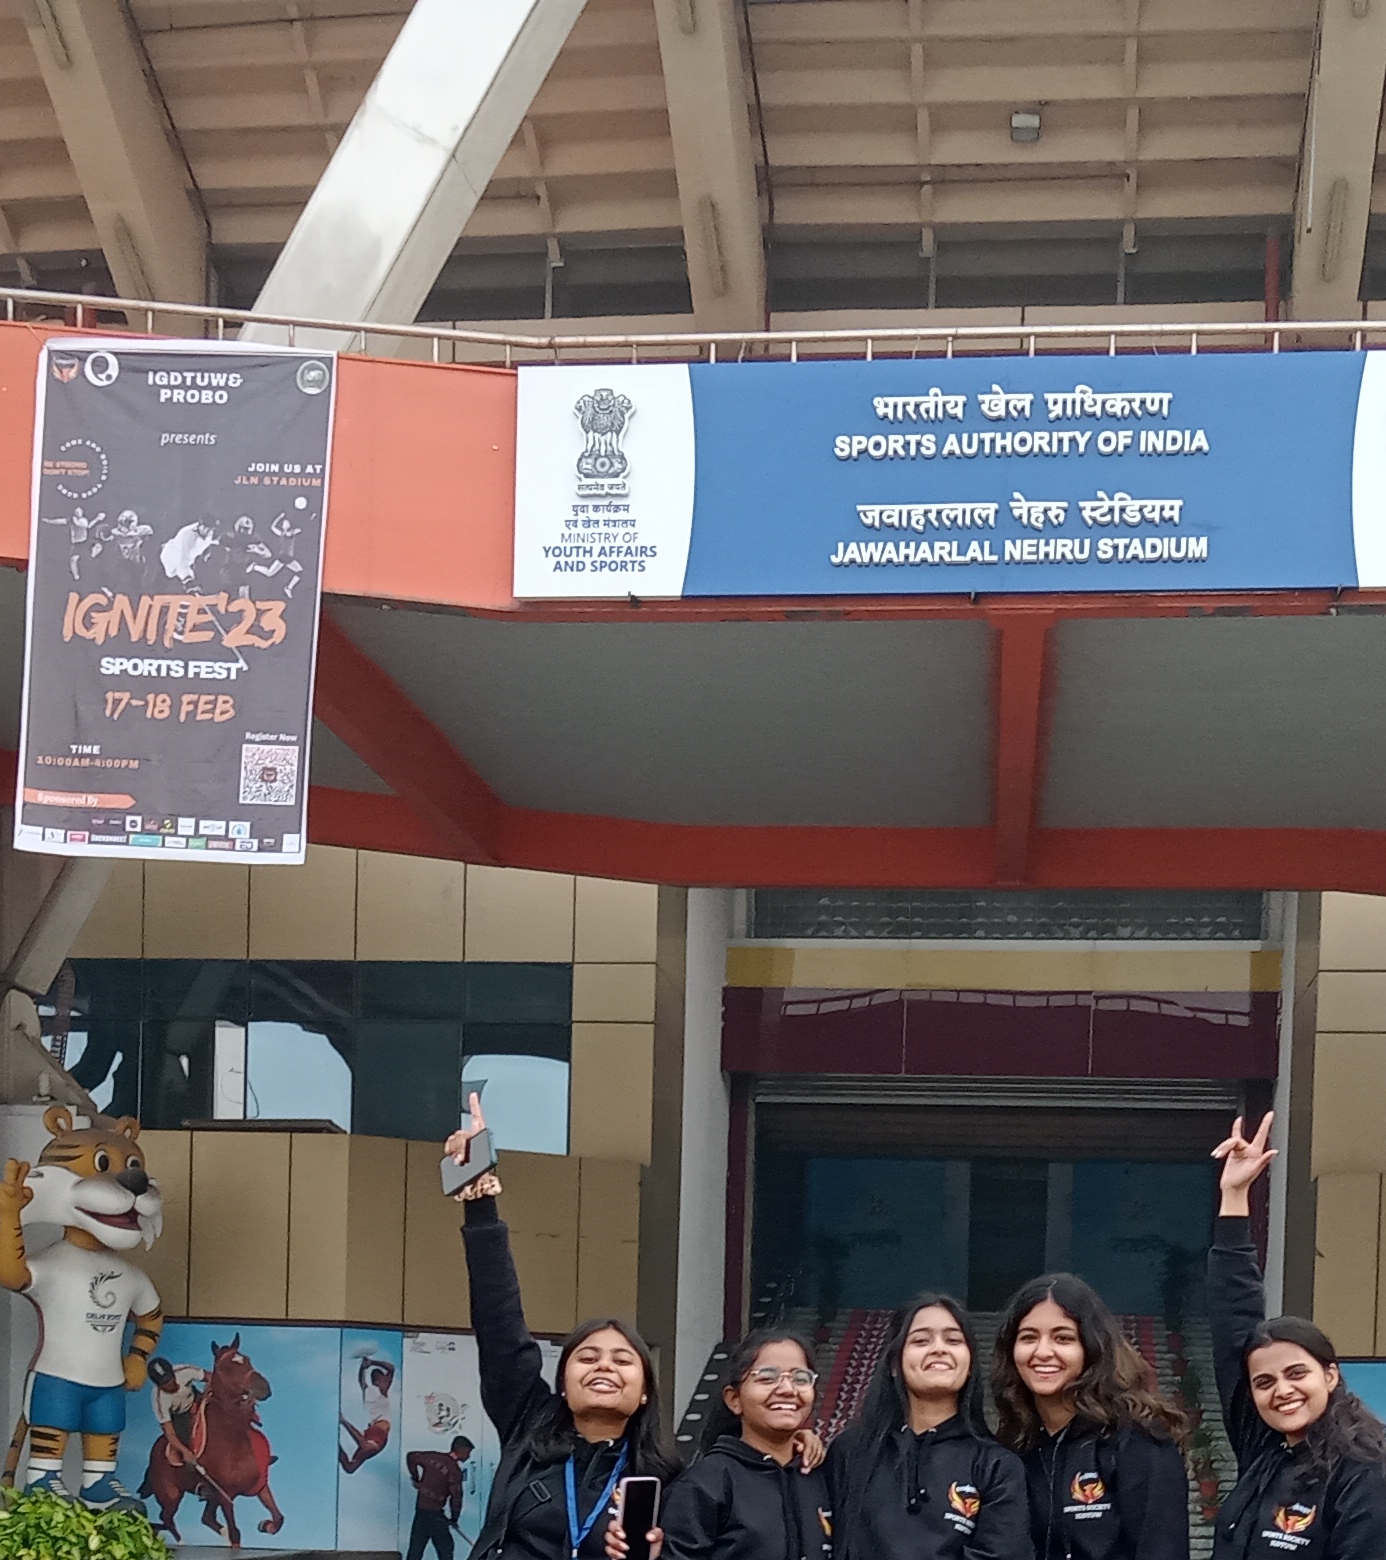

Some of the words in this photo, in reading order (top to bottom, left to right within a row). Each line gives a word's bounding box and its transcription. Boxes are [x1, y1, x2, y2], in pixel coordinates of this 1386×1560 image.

[147, 371, 243, 387] IGDTUW&
[160, 389, 229, 404] PROBO
[873, 387, 967, 422] भारतीय
[977, 384, 1034, 420] खेल
[1044, 384, 1173, 421] प्राधिकरण
[160, 432, 217, 446] presents
[834, 433, 937, 459] SPORTS
[942, 431, 1092, 458] AUTHORITY
[1097, 430, 1133, 457] OF
[1140, 429, 1210, 456] INDIA
[248, 462, 280, 473] JOIN
[283, 463, 302, 474] US
[305, 464, 323, 474] AT
[234, 475, 259, 485] JLN
[263, 476, 322, 487] STADIUM
[571, 504, 590, 516] युवा
[591, 501, 630, 514] कार्यक्रम
[856, 502, 999, 532] जवाहरलाल
[1078, 490, 1184, 528] स्टेडियम
[560, 532, 619, 544] MINISTRY
[622, 532, 639, 544] OF
[542, 546, 593, 558] YOUTH
[597, 545, 657, 558] AFFAIRS
[830, 540, 998, 567] JAWAHARLAL
[1004, 538, 1090, 564] NEHRU
[1097, 536, 1208, 563] STADIUM
[553, 560, 586, 572] AND
[590, 560, 646, 573] SPORTS
[100, 656, 184, 678] SPORTS
[188, 660, 242, 680] FEST
[104, 690, 172, 720] 17-18
[179, 693, 236, 722] FEB
[69, 744, 101, 755] TIME
[37, 792, 87, 805] Sponsored
